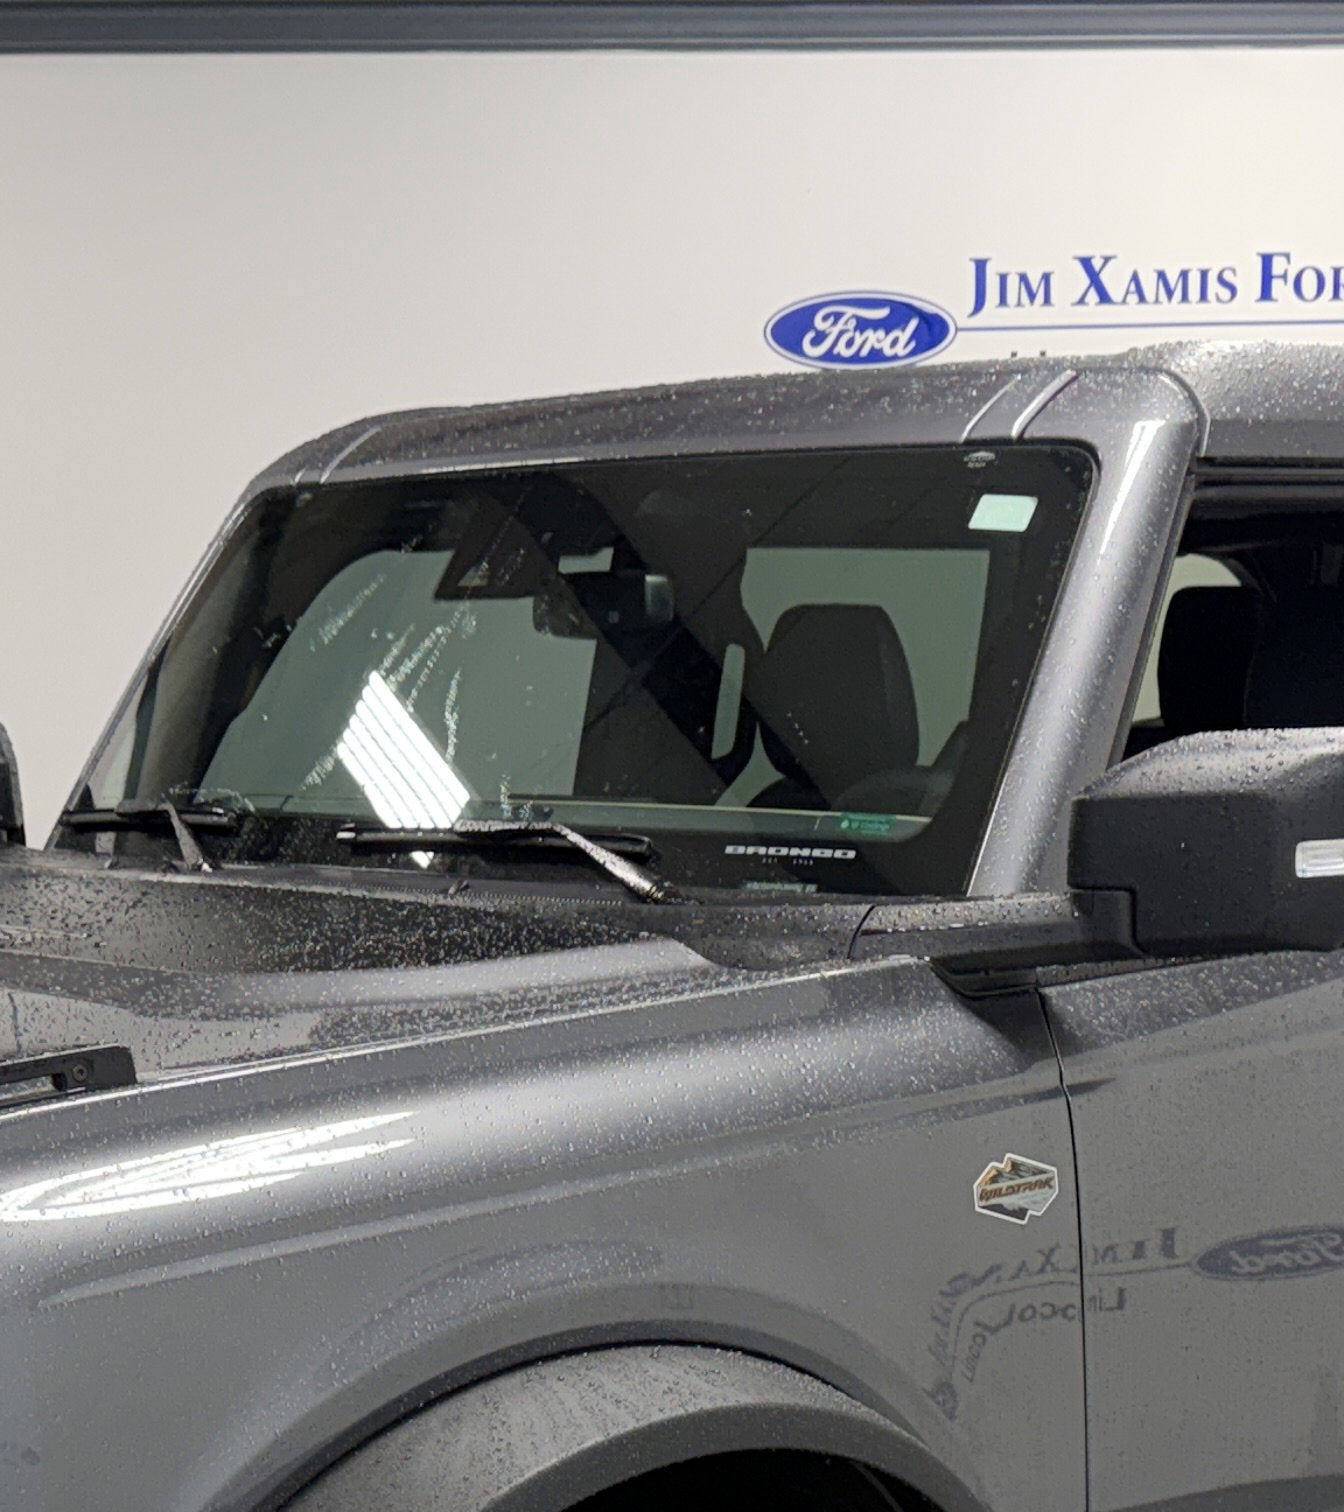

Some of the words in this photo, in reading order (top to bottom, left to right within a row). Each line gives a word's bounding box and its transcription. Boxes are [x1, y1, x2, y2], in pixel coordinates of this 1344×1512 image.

[967, 257, 1055, 318] JIM
[1071, 254, 1239, 307] XAMIS
[802, 304, 920, 358] Ford
[724, 845, 856, 859] BRONCO
